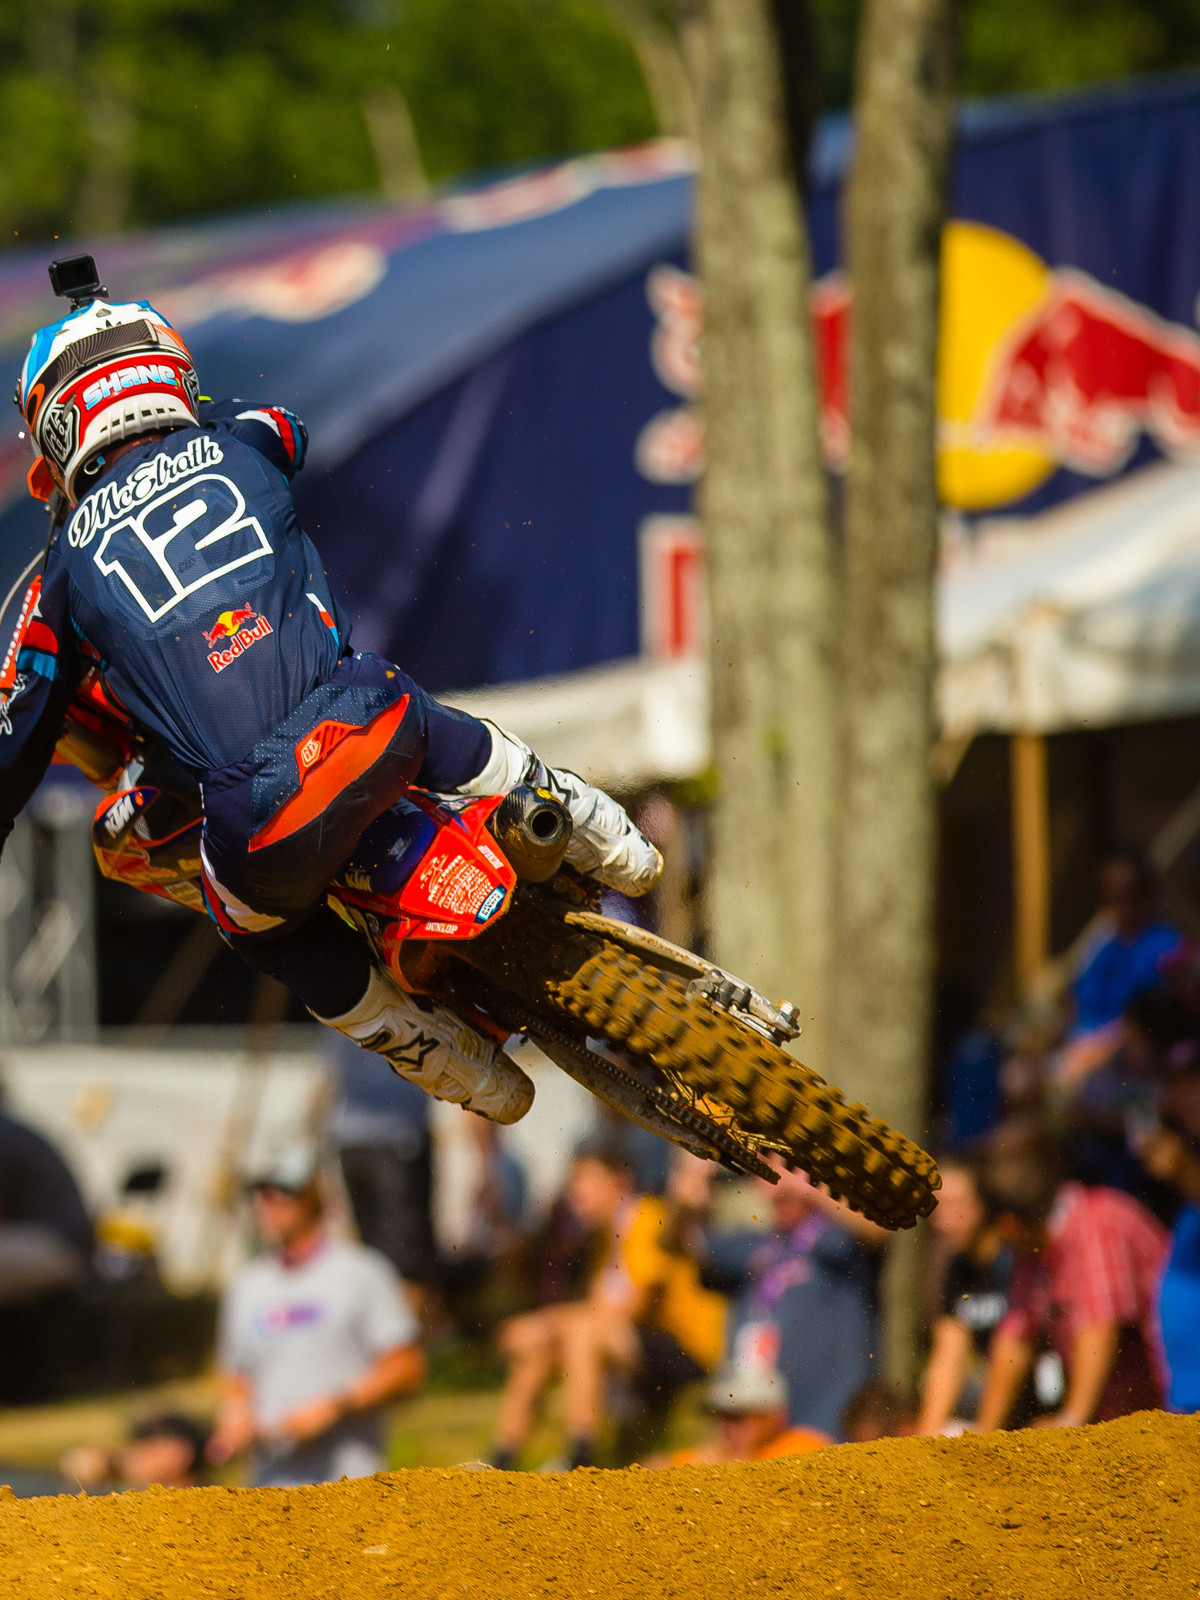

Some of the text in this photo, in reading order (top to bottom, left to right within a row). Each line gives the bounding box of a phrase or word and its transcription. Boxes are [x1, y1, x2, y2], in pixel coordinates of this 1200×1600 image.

[68, 435, 224, 549] McElrath
[92, 473, 274, 623] 12
[206, 615, 274, 674] Red Bull
[104, 794, 136, 840] KTM
[425, 921, 459, 935] DUNLOP
